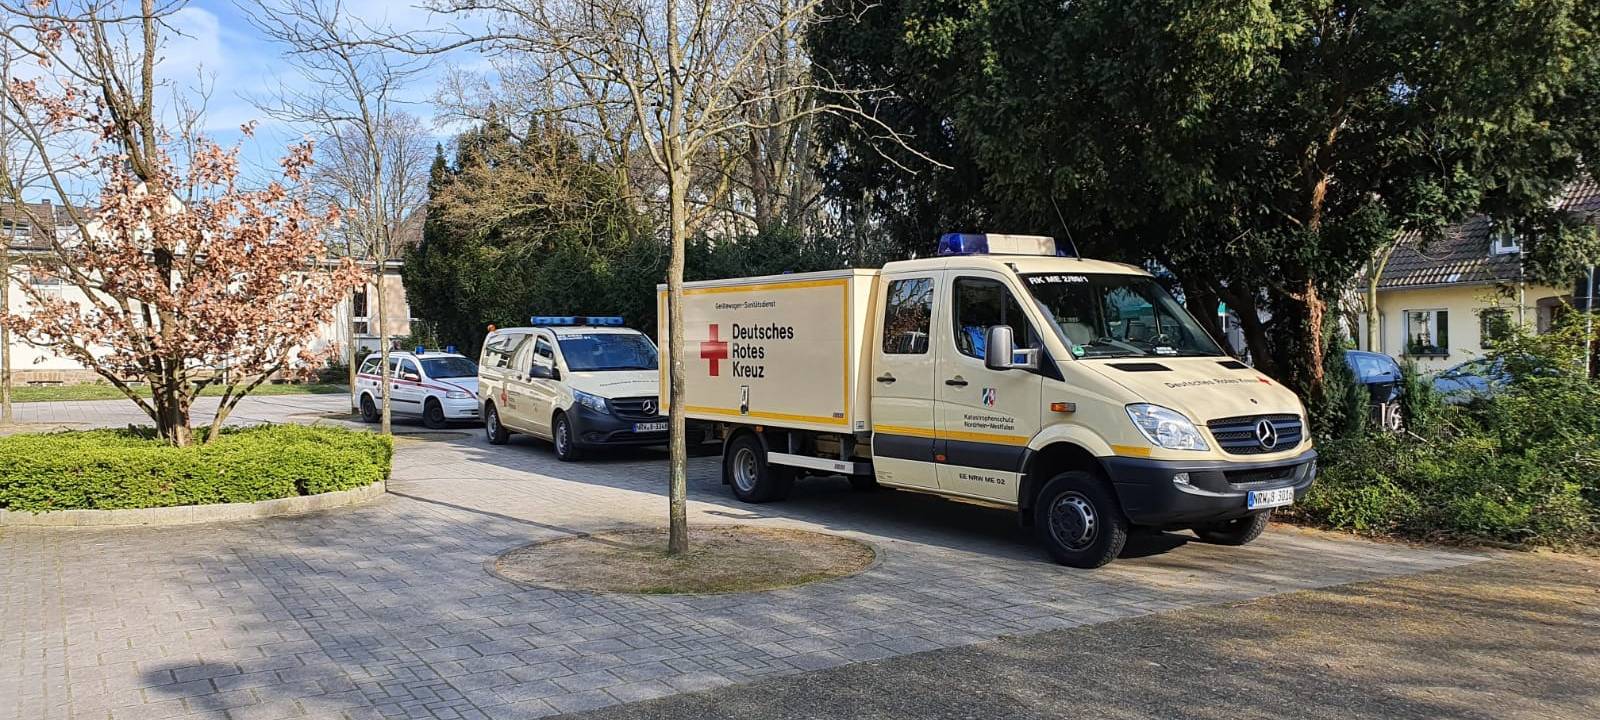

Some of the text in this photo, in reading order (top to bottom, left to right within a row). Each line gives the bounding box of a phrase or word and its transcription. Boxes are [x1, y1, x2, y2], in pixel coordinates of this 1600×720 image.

[1029, 276, 1046, 284] RK
[1045, 275, 1062, 283] ME
[732, 322, 794, 340] Deutsches
[732, 342, 765, 359] Rotes
[732, 361, 765, 378] Kreuz
[969, 474, 984, 482] NRW
[985, 476, 996, 484] ME
[996, 478, 1006, 486] 02
[1253, 492, 1268, 504] NRW
